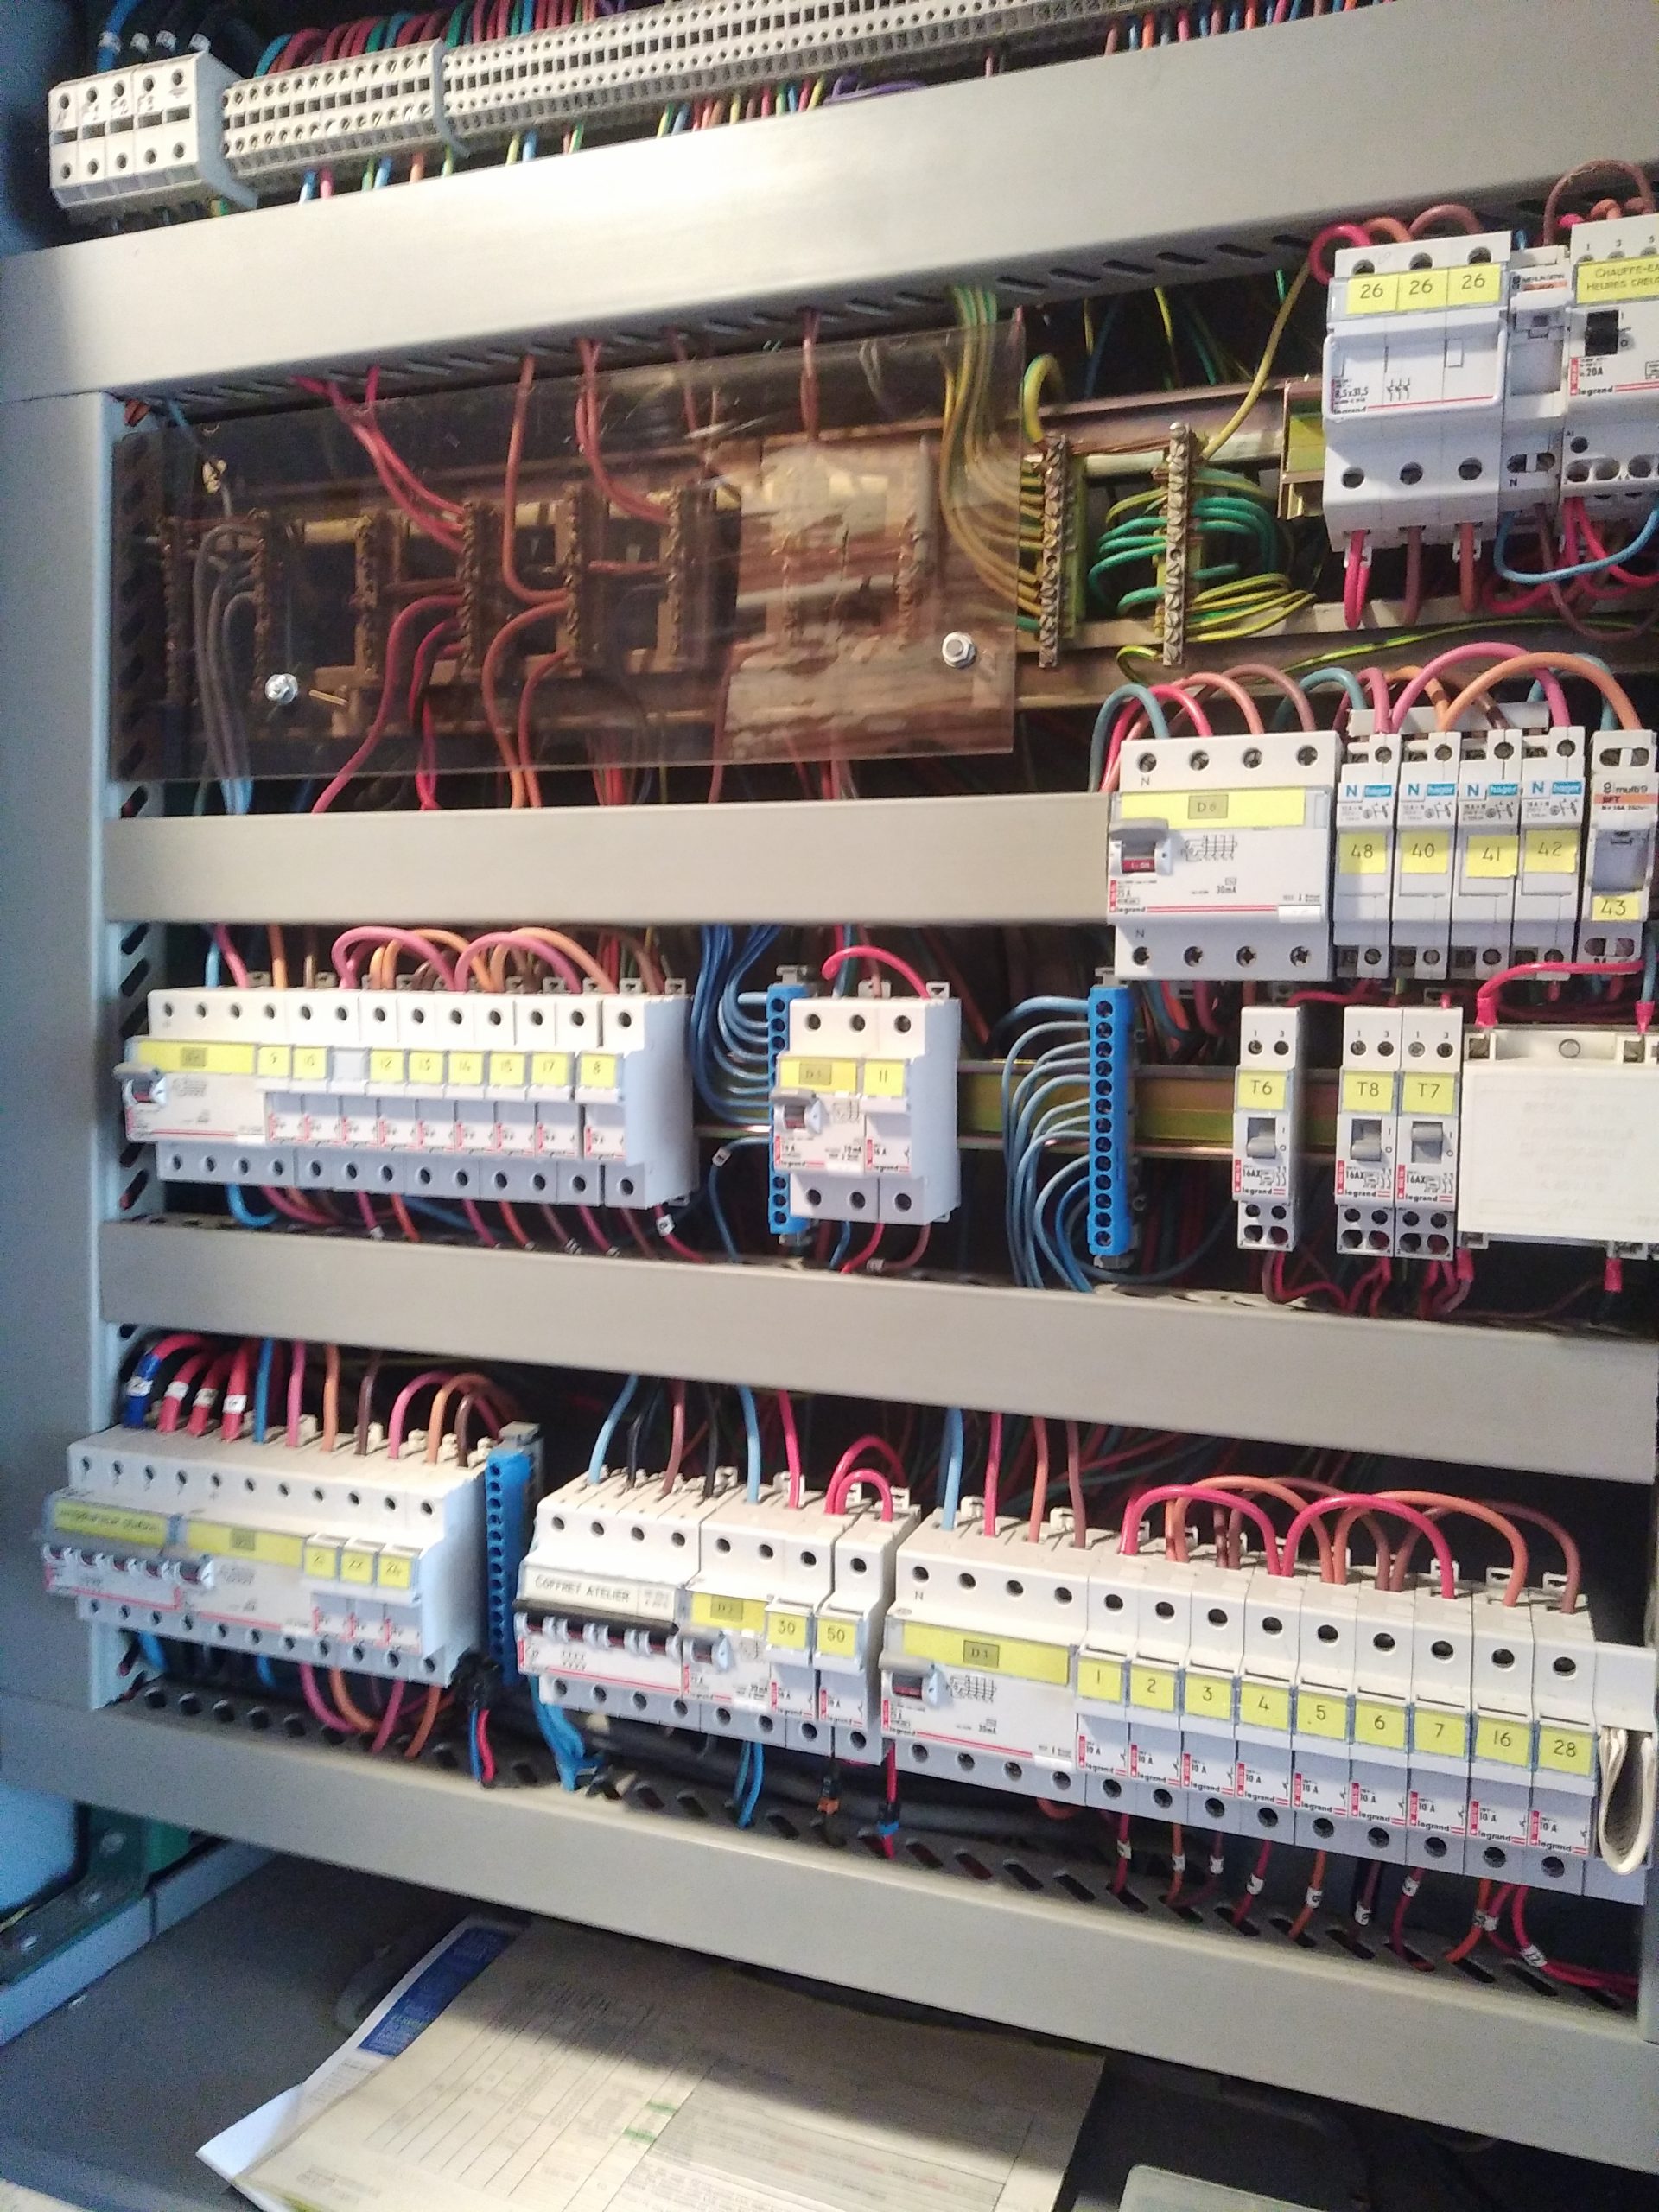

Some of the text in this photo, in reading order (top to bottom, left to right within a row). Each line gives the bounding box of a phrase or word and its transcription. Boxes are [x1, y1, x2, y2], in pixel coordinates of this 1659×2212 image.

[1408, 278, 1433, 296] 26
[1460, 272, 1486, 290] 26
[1359, 283, 1384, 300] 26
[1579, 385, 1614, 397] legrand
[1509, 478, 1518, 487] N
[1141, 776, 1151, 786] N
[1532, 781, 1545, 794] N
[1346, 784, 1357, 797] N
[1408, 783, 1420, 796] N
[1468, 784, 1479, 797] N
[1351, 843, 1374, 859] 48
[1411, 842, 1435, 858] 40
[1482, 846, 1501, 862] 41
[1537, 841, 1563, 857] 42
[1600, 899, 1627, 916] 43
[1135, 928, 1145, 938] N
[1249, 1079, 1273, 1096] T6
[1357, 1081, 1380, 1097] T8
[1417, 1083, 1440, 1099] T7
[1242, 1187, 1273, 1196] legrand
[1344, 1189, 1376, 1198] legrand
[1405, 1193, 1439, 1203] legrand
[586, 1586, 630, 1603] ATELIER
[914, 1590, 924, 1601] N
[1096, 1669, 1101, 1684] 1
[1147, 1678, 1157, 1694] 2
[1202, 1686, 1213, 1702] 3
[1258, 1695, 1270, 1711] 4
[1315, 1704, 1327, 1721] 5
[1374, 1714, 1386, 1730] 6
[1435, 1722, 1445, 1738] 7
[1493, 1729, 1511, 1747] 16
[1553, 1738, 1577, 1758] 28
[1085, 1764, 1114, 1774] legrand
[1137, 1772, 1166, 1783] legrand
[1191, 1781, 1220, 1792] legrand
[1244, 1790, 1275, 1802] legrand
[1301, 1801, 1332, 1813] legrand
[1358, 1810, 1391, 1823] legrand
[1417, 1820, 1450, 1833] legrand
[1478, 1830, 1511, 1843] legrand
[1538, 1840, 1572, 1853] legrand
